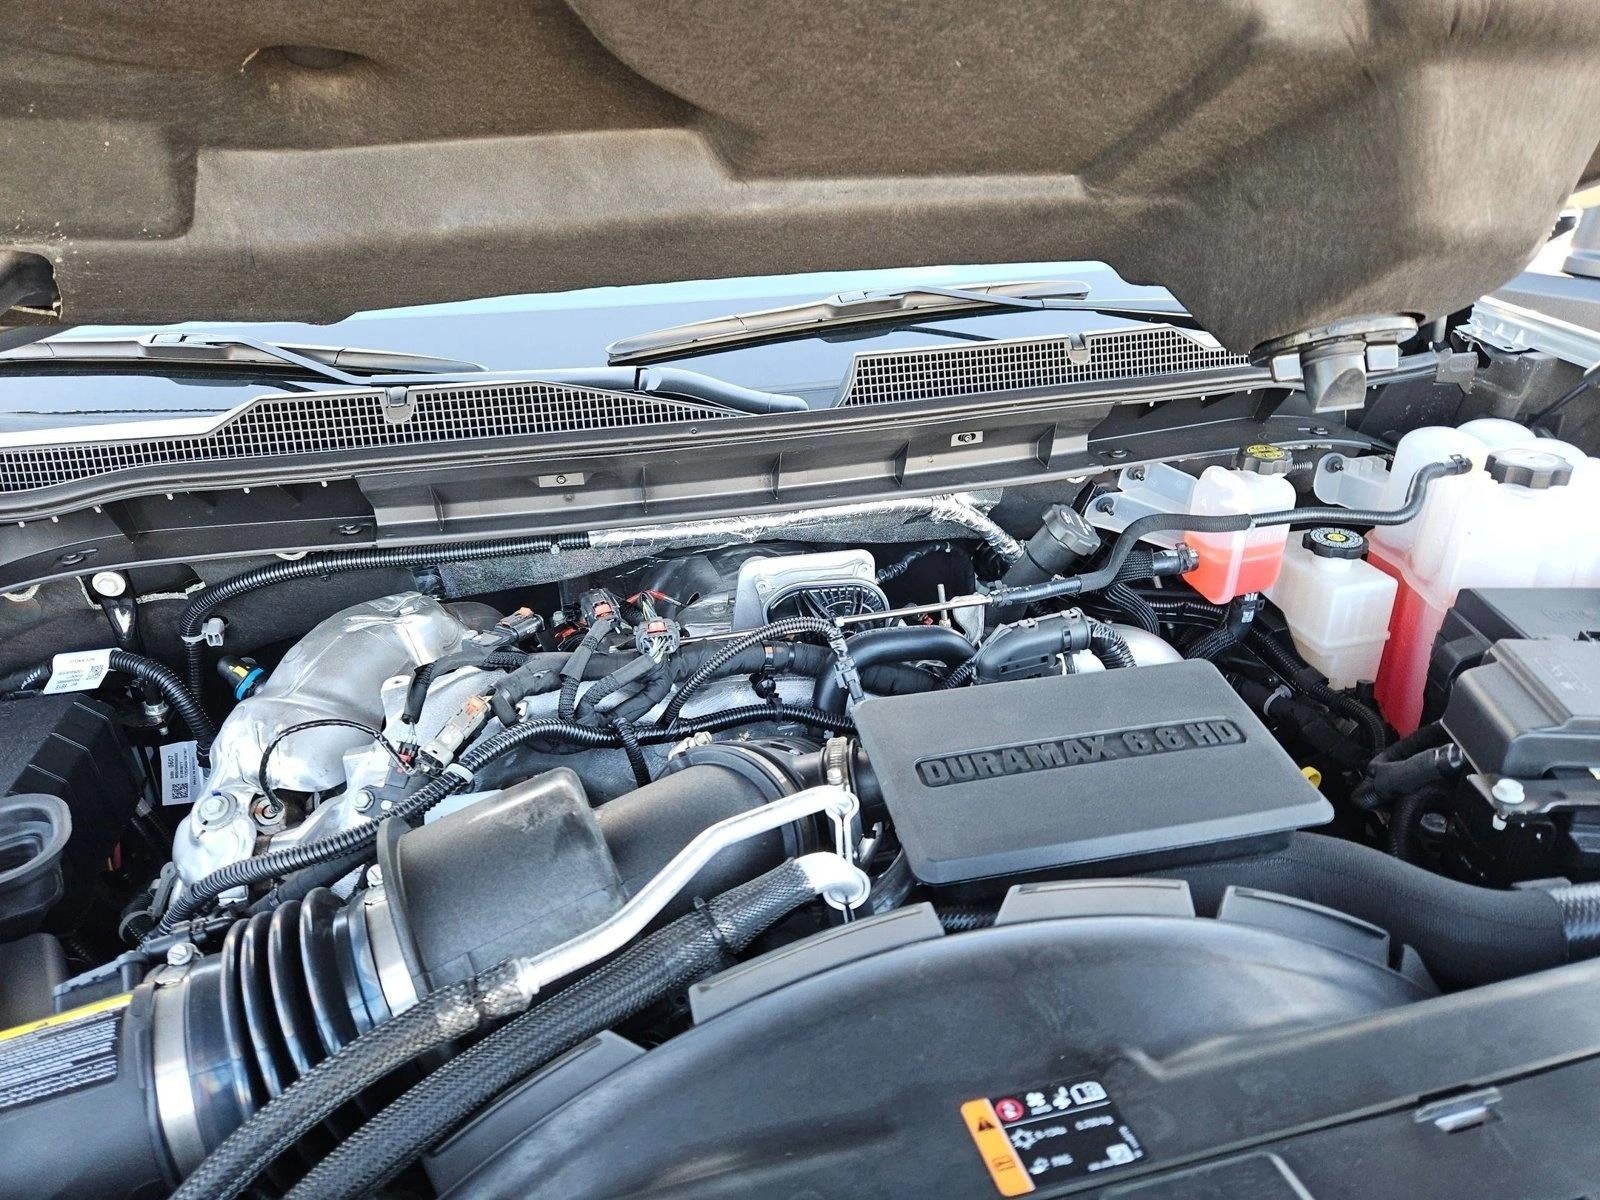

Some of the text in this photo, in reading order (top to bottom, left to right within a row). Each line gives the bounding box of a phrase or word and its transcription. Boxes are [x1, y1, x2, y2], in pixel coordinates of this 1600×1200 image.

[921, 719, 1242, 786] DURAMAX 6.6 HD
